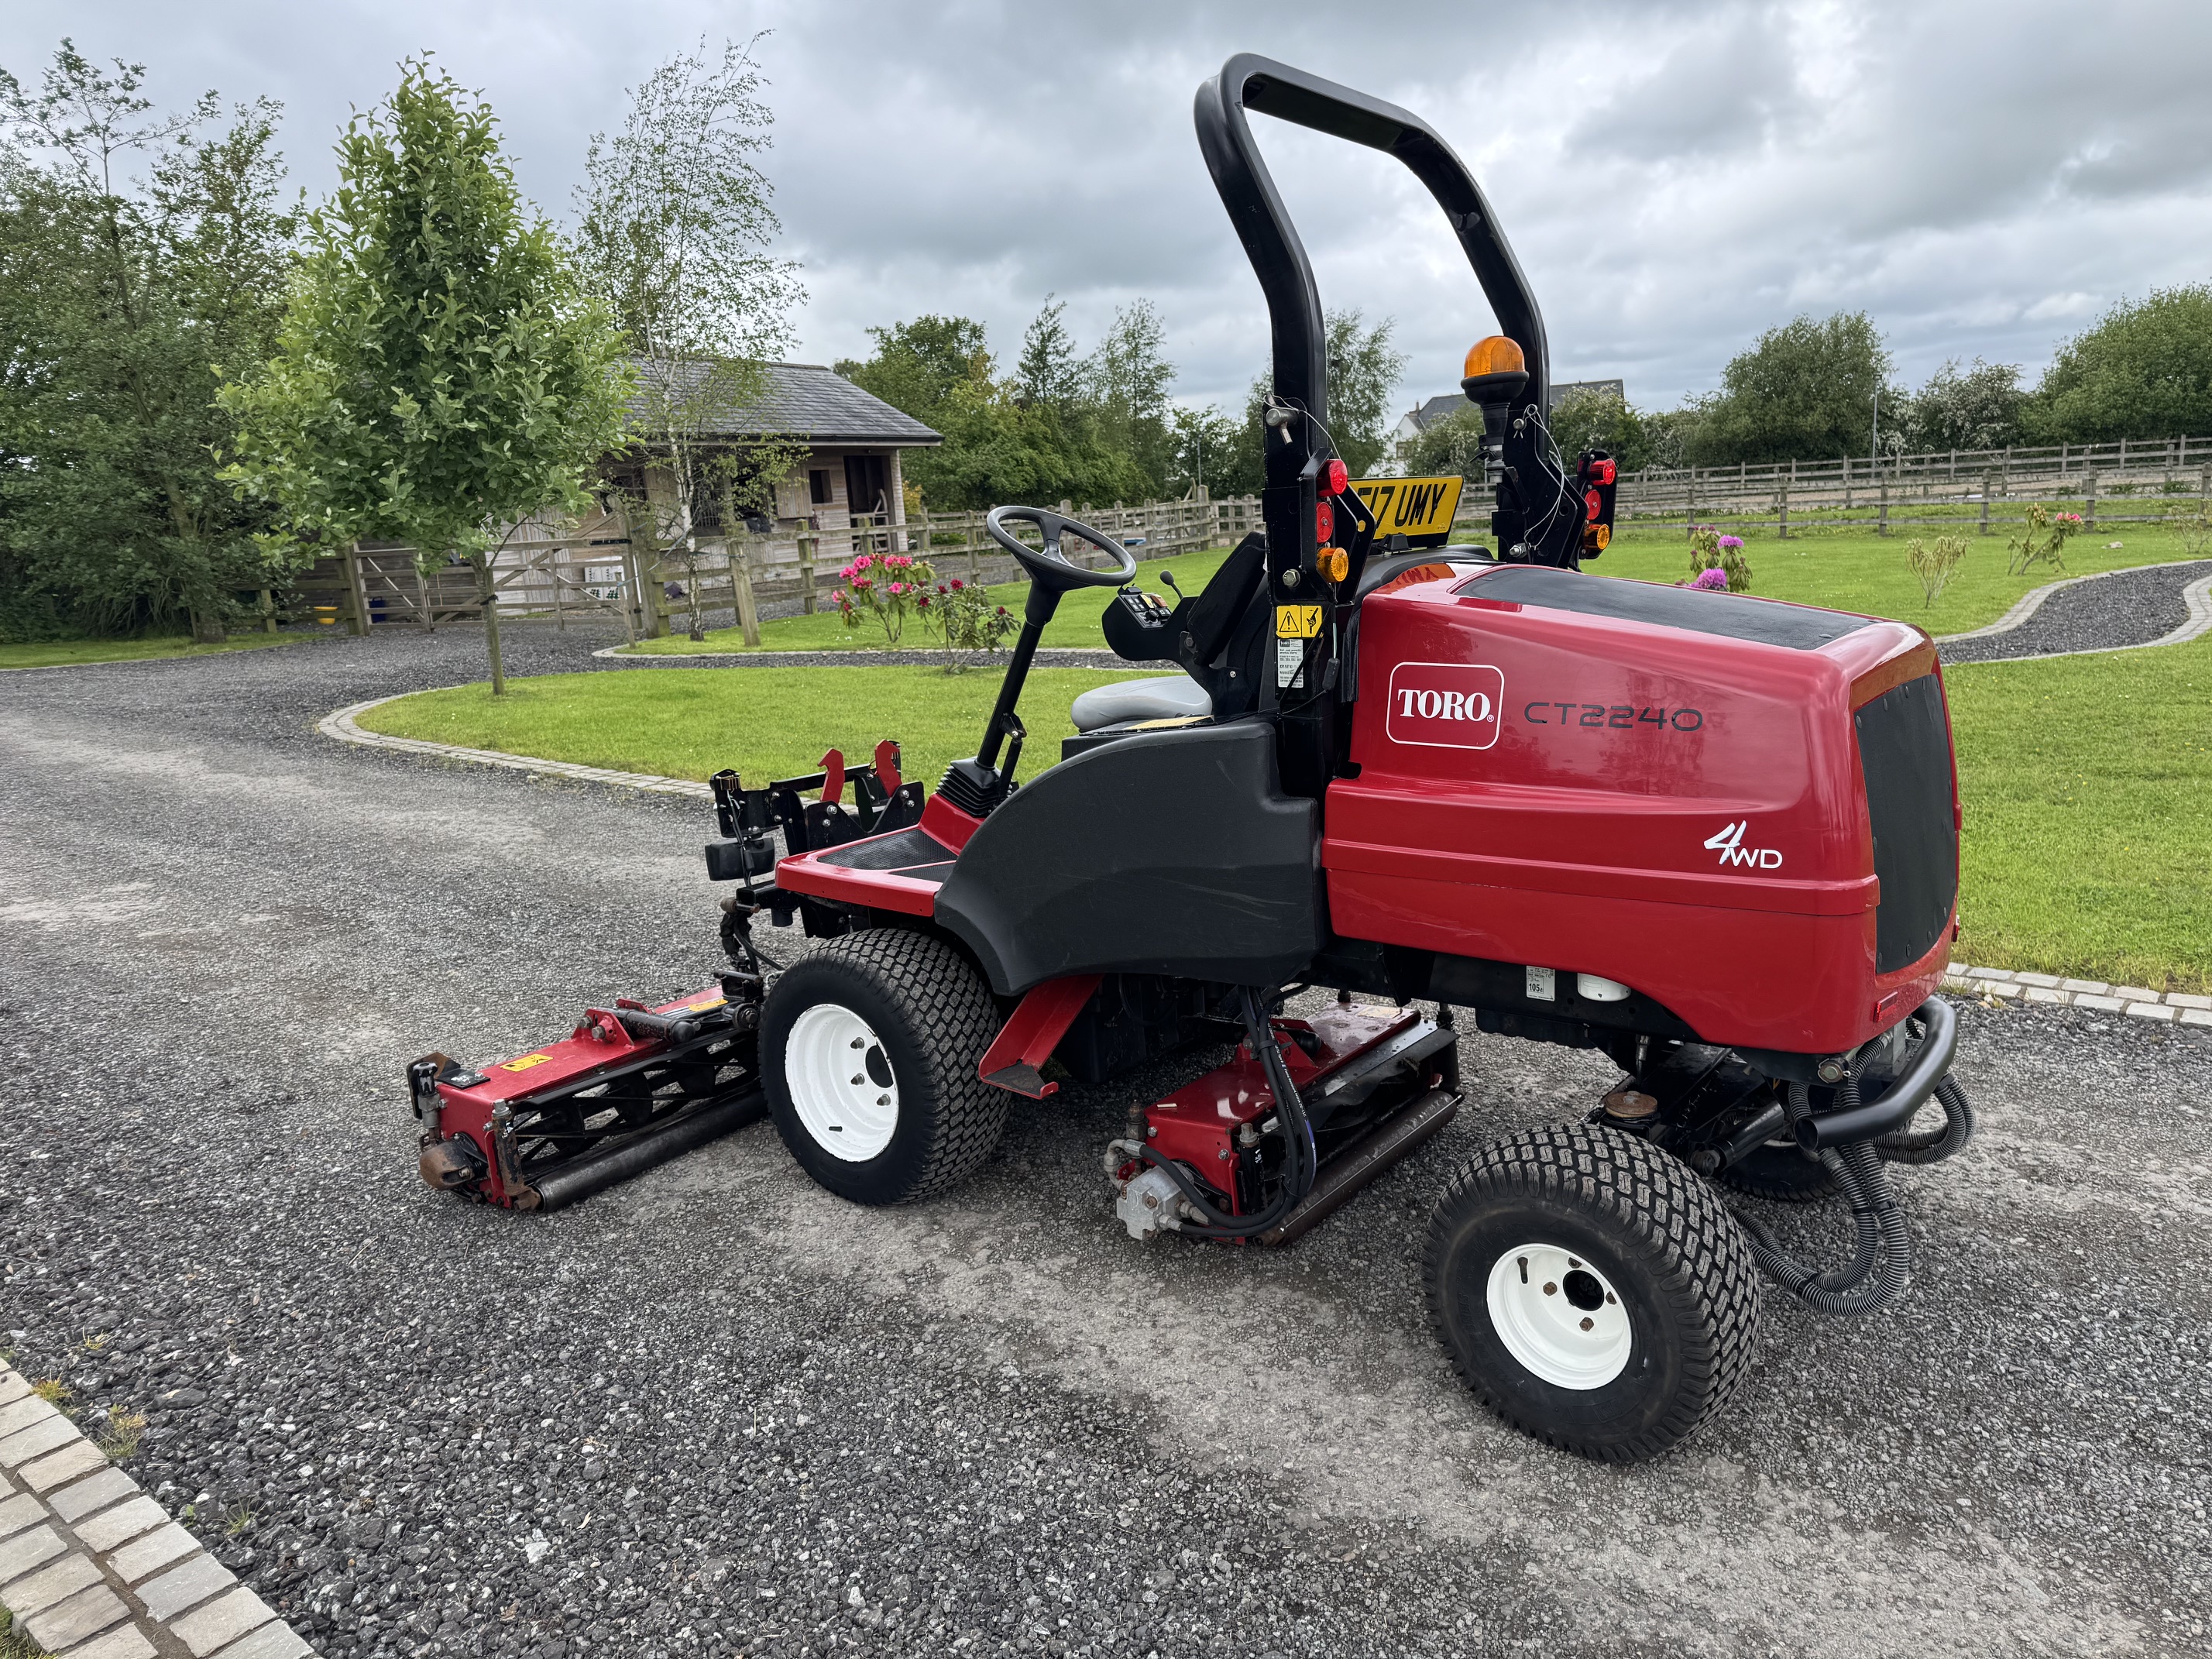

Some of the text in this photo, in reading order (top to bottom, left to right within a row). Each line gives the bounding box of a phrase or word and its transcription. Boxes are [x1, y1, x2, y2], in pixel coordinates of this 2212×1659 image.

[1357, 483, 1448, 529] 17 UMY
[1524, 702, 1703, 732] CT2240
[1704, 819, 1783, 869] 4WD
